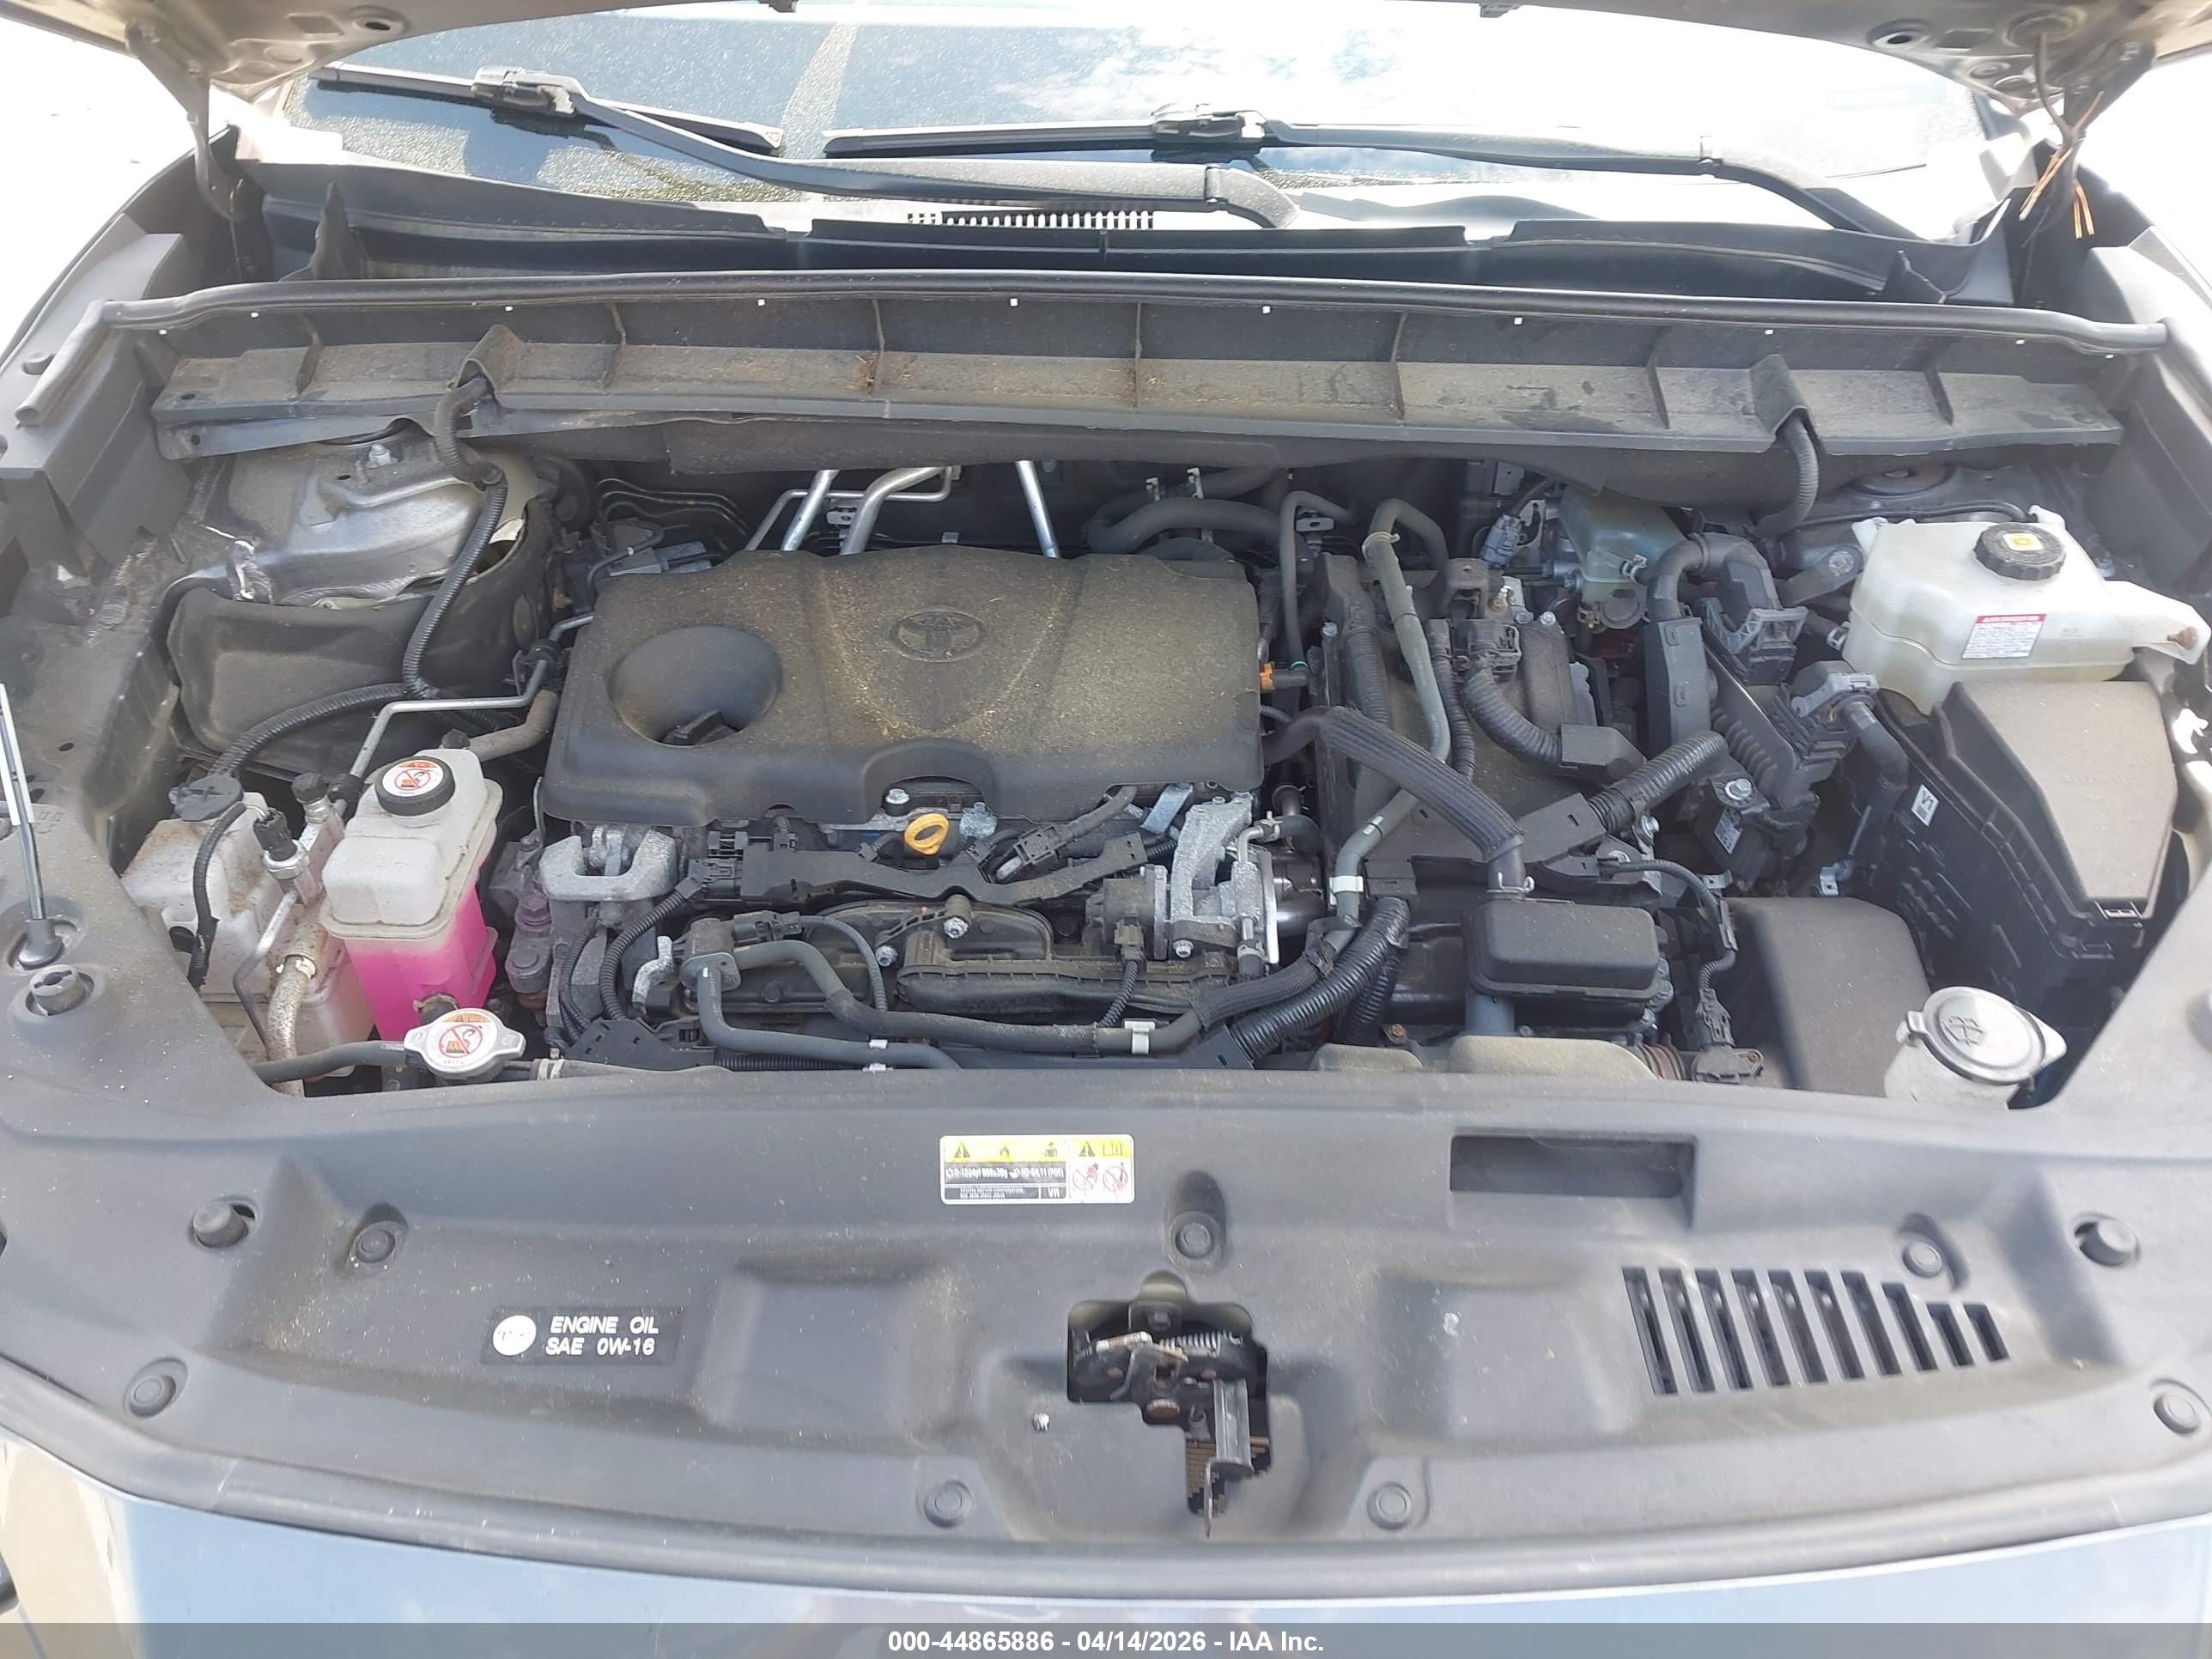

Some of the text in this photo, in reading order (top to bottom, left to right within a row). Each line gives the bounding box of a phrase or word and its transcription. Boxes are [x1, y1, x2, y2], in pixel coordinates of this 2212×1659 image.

[551, 1316, 658, 1334] ENGINE OIL
[546, 1338, 654, 1355] SAE 0W-16
